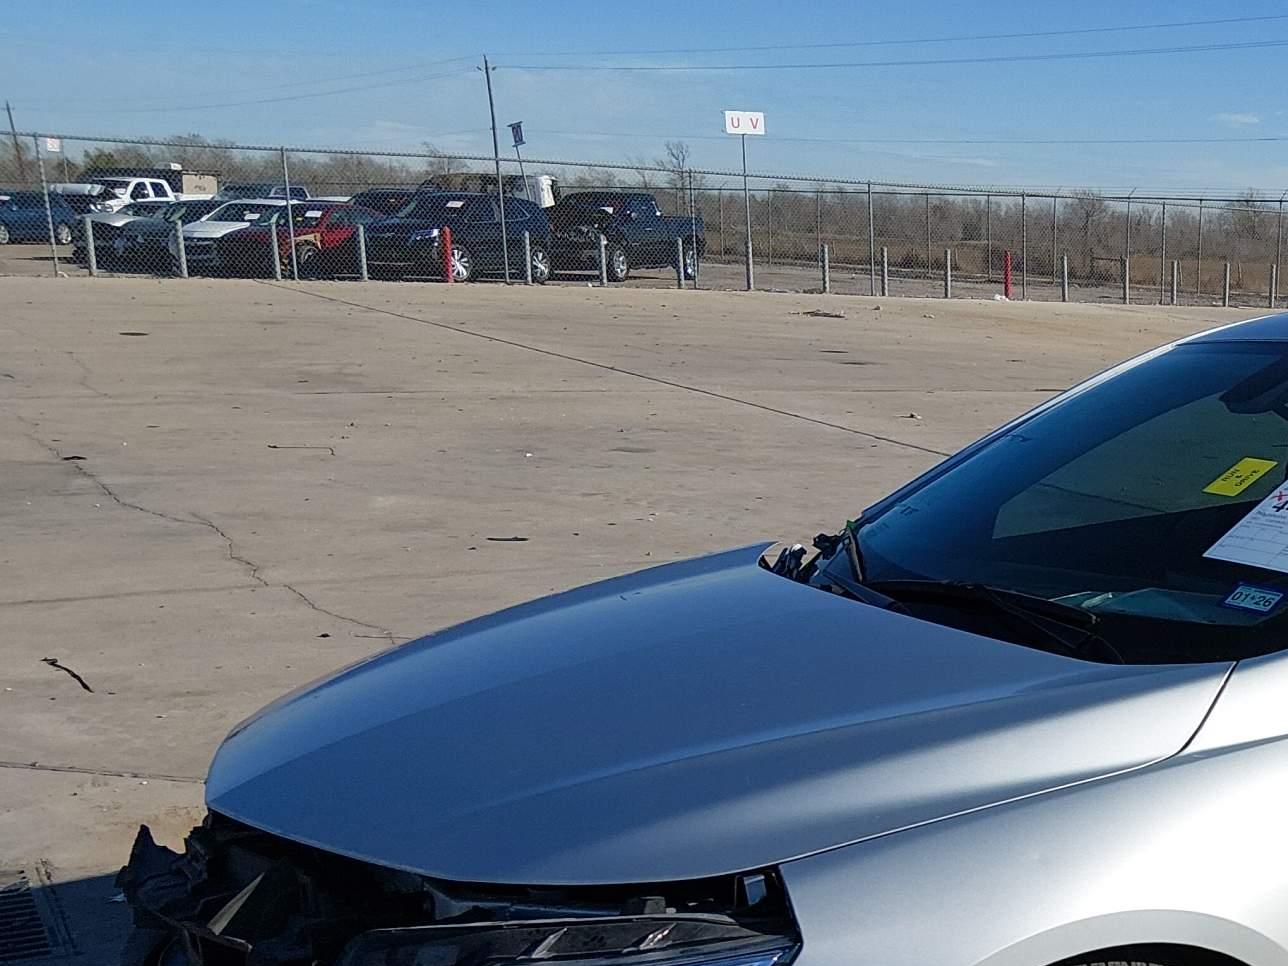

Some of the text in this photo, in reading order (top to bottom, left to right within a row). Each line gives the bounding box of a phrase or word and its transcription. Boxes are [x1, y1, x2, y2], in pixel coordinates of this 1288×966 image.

[731, 116, 760, 129] U V
[1221, 468, 1241, 482] RUN
[1234, 470, 1260, 487] DRIVE
